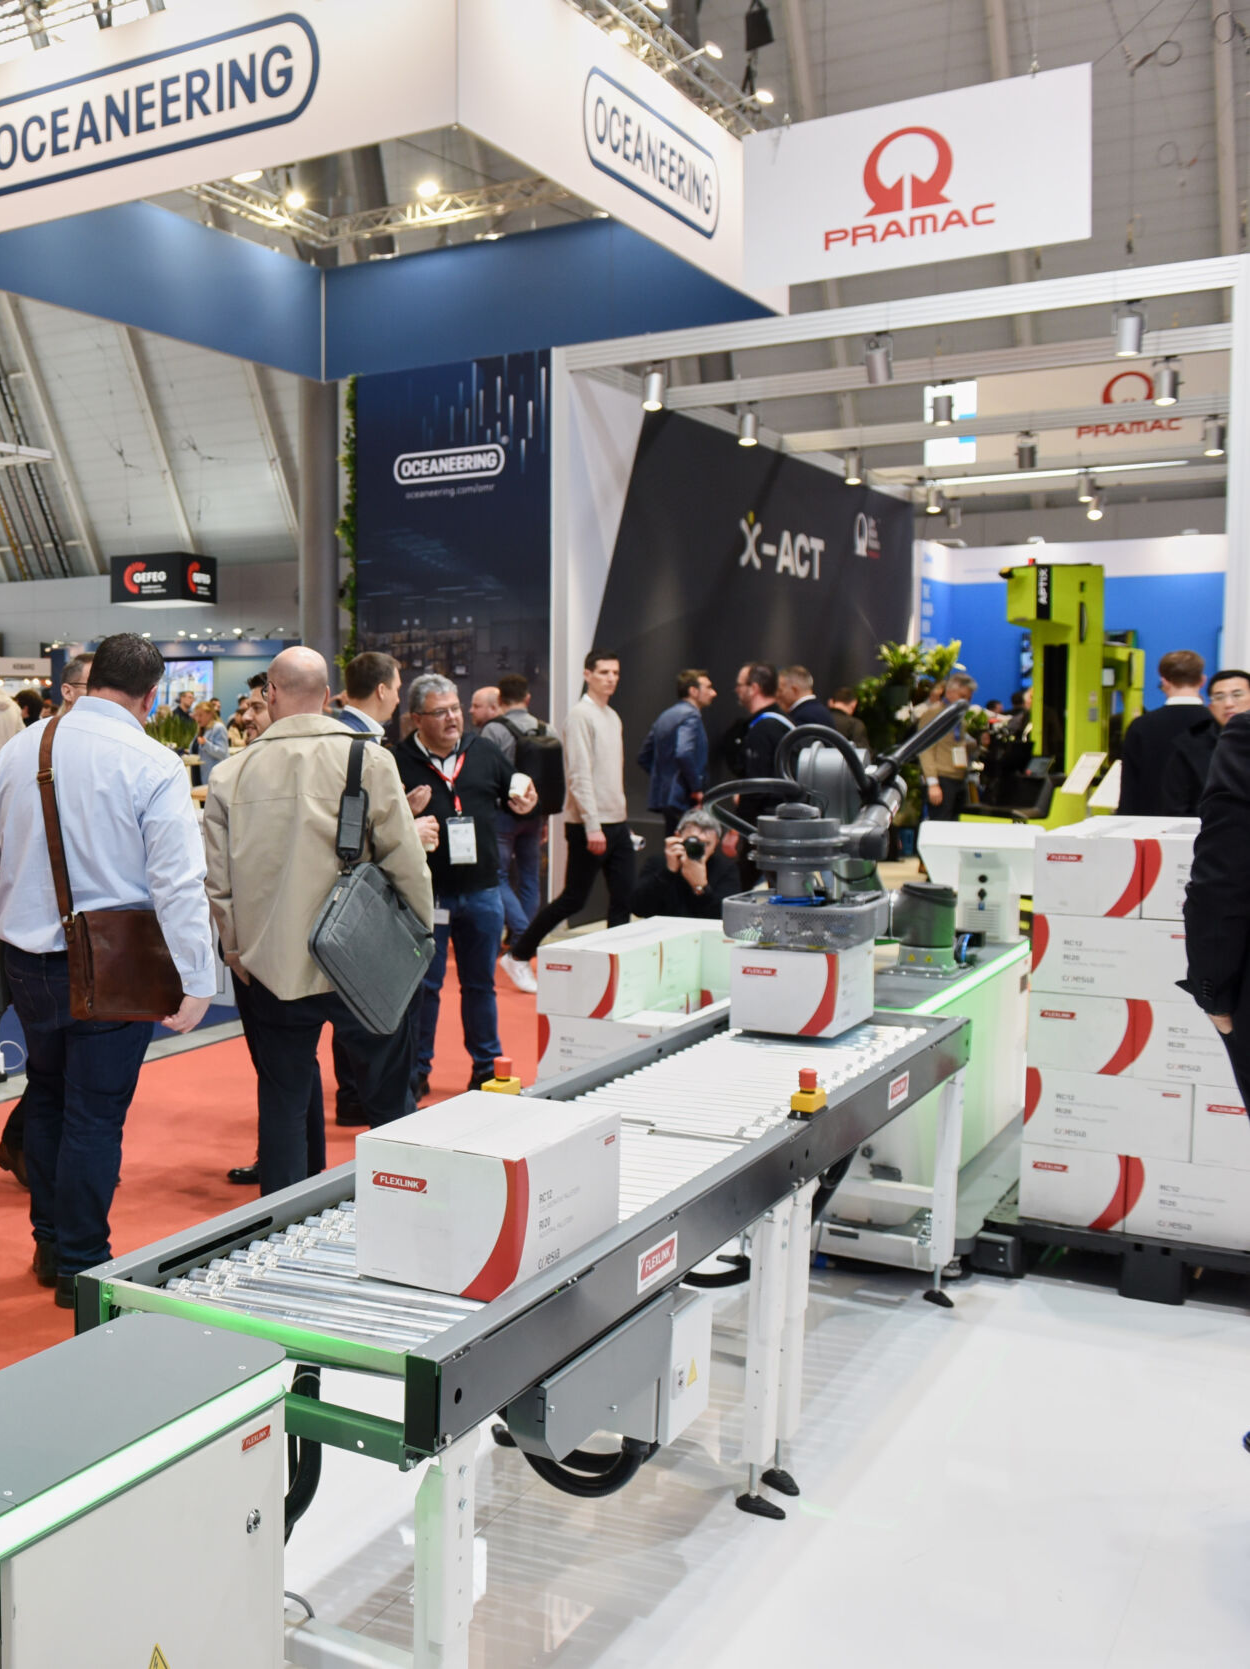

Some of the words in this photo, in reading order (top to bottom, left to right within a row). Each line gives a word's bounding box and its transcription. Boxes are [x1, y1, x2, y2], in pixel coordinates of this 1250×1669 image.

[594, 96, 713, 215] OCEANEERING
[824, 203, 996, 251] PRAMAC
[1076, 417, 1182, 440] PRAMAC
[400, 452, 498, 477] OCEANEERING
[739, 516, 826, 581] X-ACT
[380, 1175, 419, 1189] FLEXLINK
[645, 1245, 671, 1273] FLEXLINK
